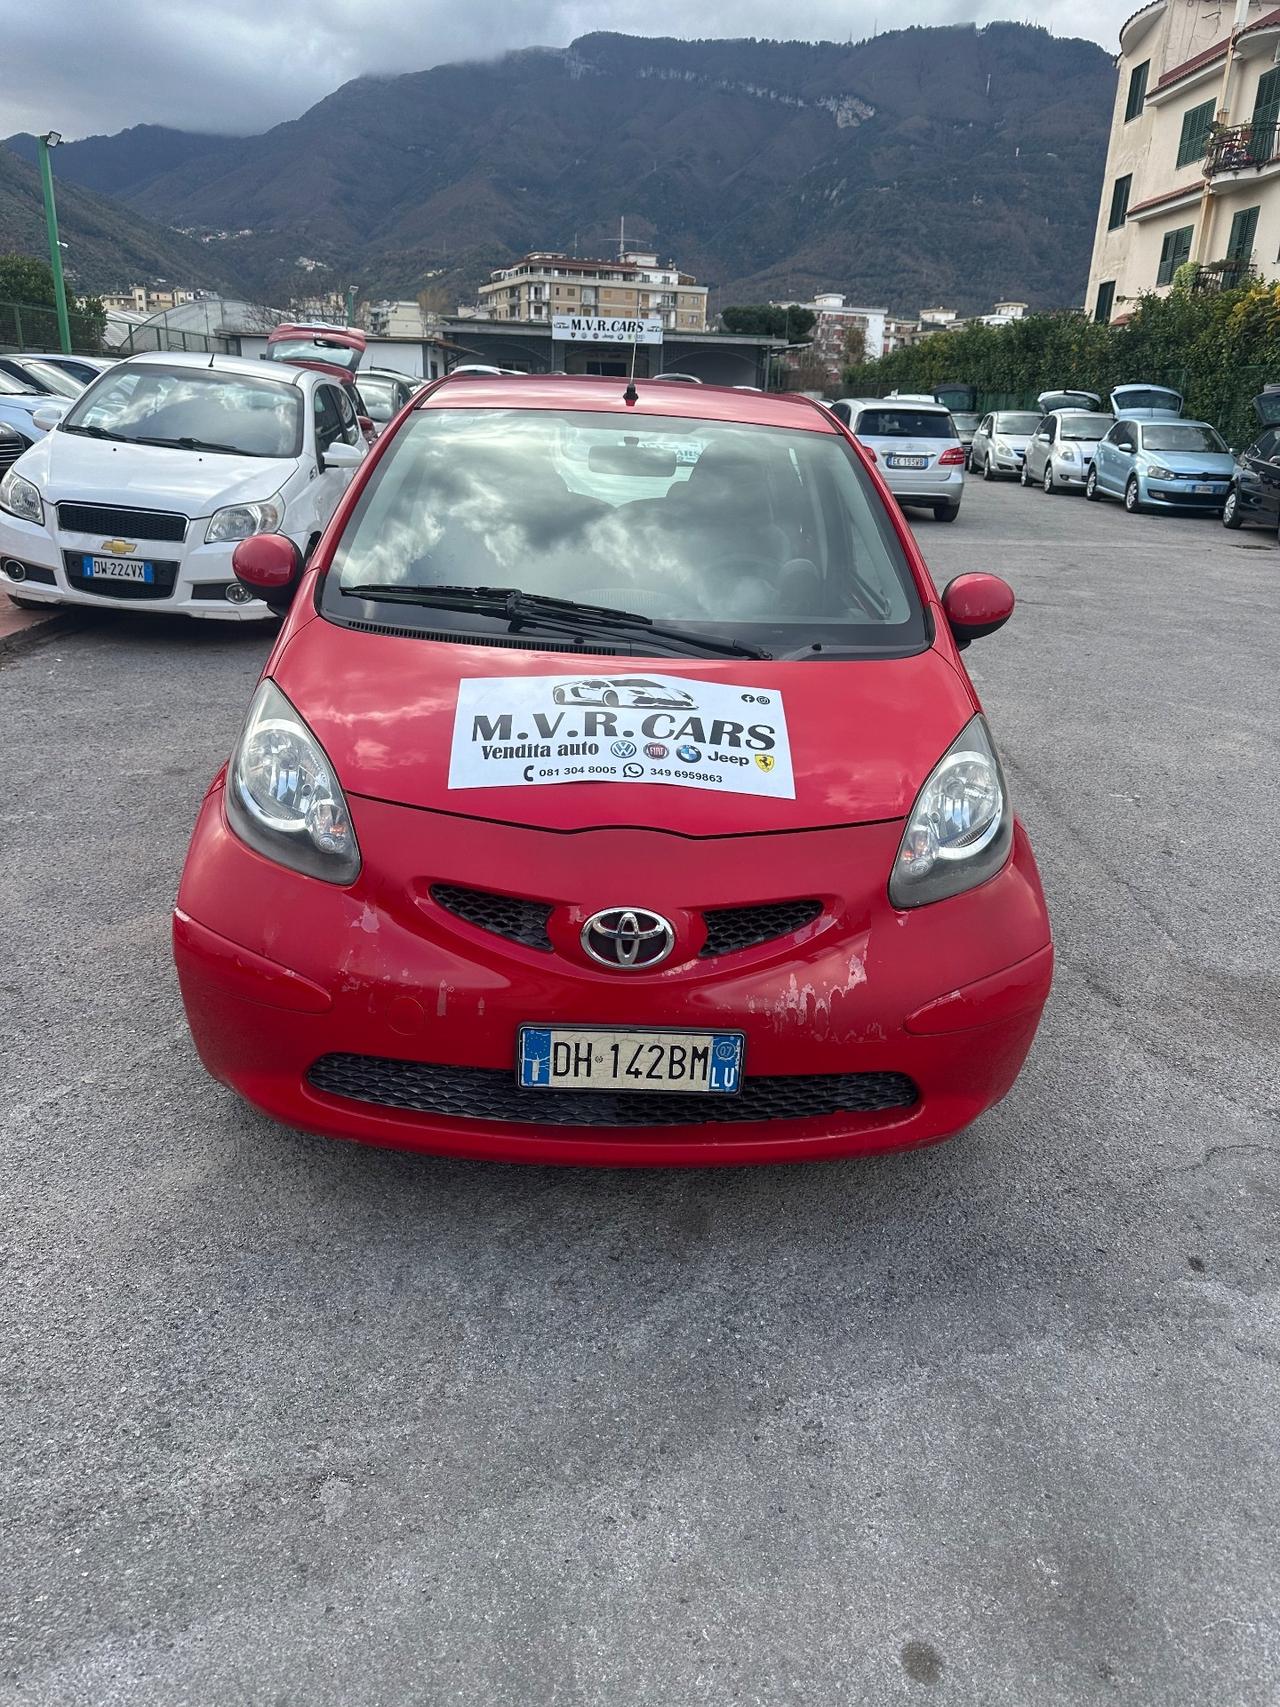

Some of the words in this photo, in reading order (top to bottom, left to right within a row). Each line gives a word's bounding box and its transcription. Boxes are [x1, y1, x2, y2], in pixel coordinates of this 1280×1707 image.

[481, 743, 551, 760] Vendita
[557, 741, 599, 757] auto
[708, 751, 749, 766] Jeep
[539, 768, 560, 777] 081
[564, 766, 585, 776] 304
[588, 765, 617, 775] 8005
[650, 767, 671, 777] 349
[674, 769, 723, 783] 6959863
[552, 1041, 593, 1077] DH
[610, 1043, 710, 1081] 142BM
